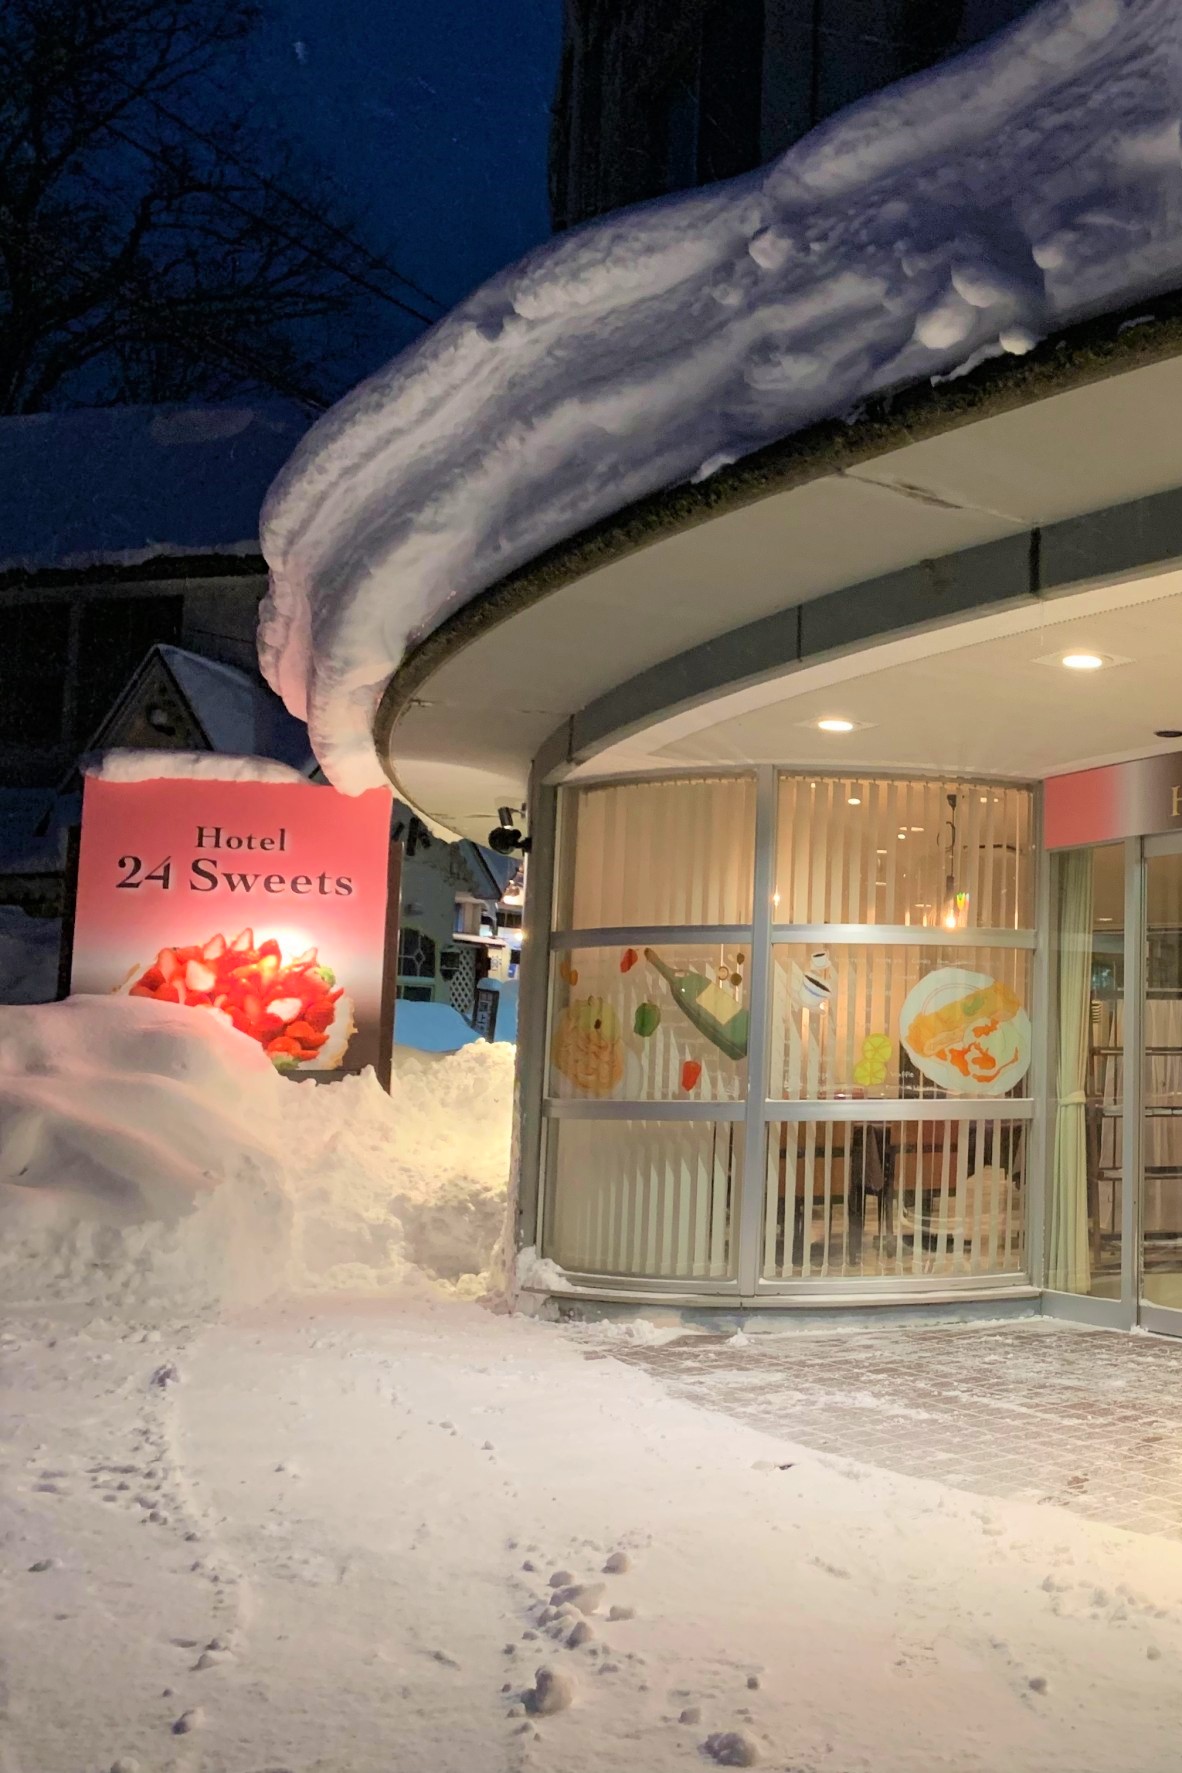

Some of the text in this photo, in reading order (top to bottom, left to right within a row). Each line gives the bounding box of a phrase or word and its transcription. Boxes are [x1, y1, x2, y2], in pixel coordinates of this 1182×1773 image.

[195, 826, 286, 852] Hotel
[115, 855, 353, 897] 24 Sweets
